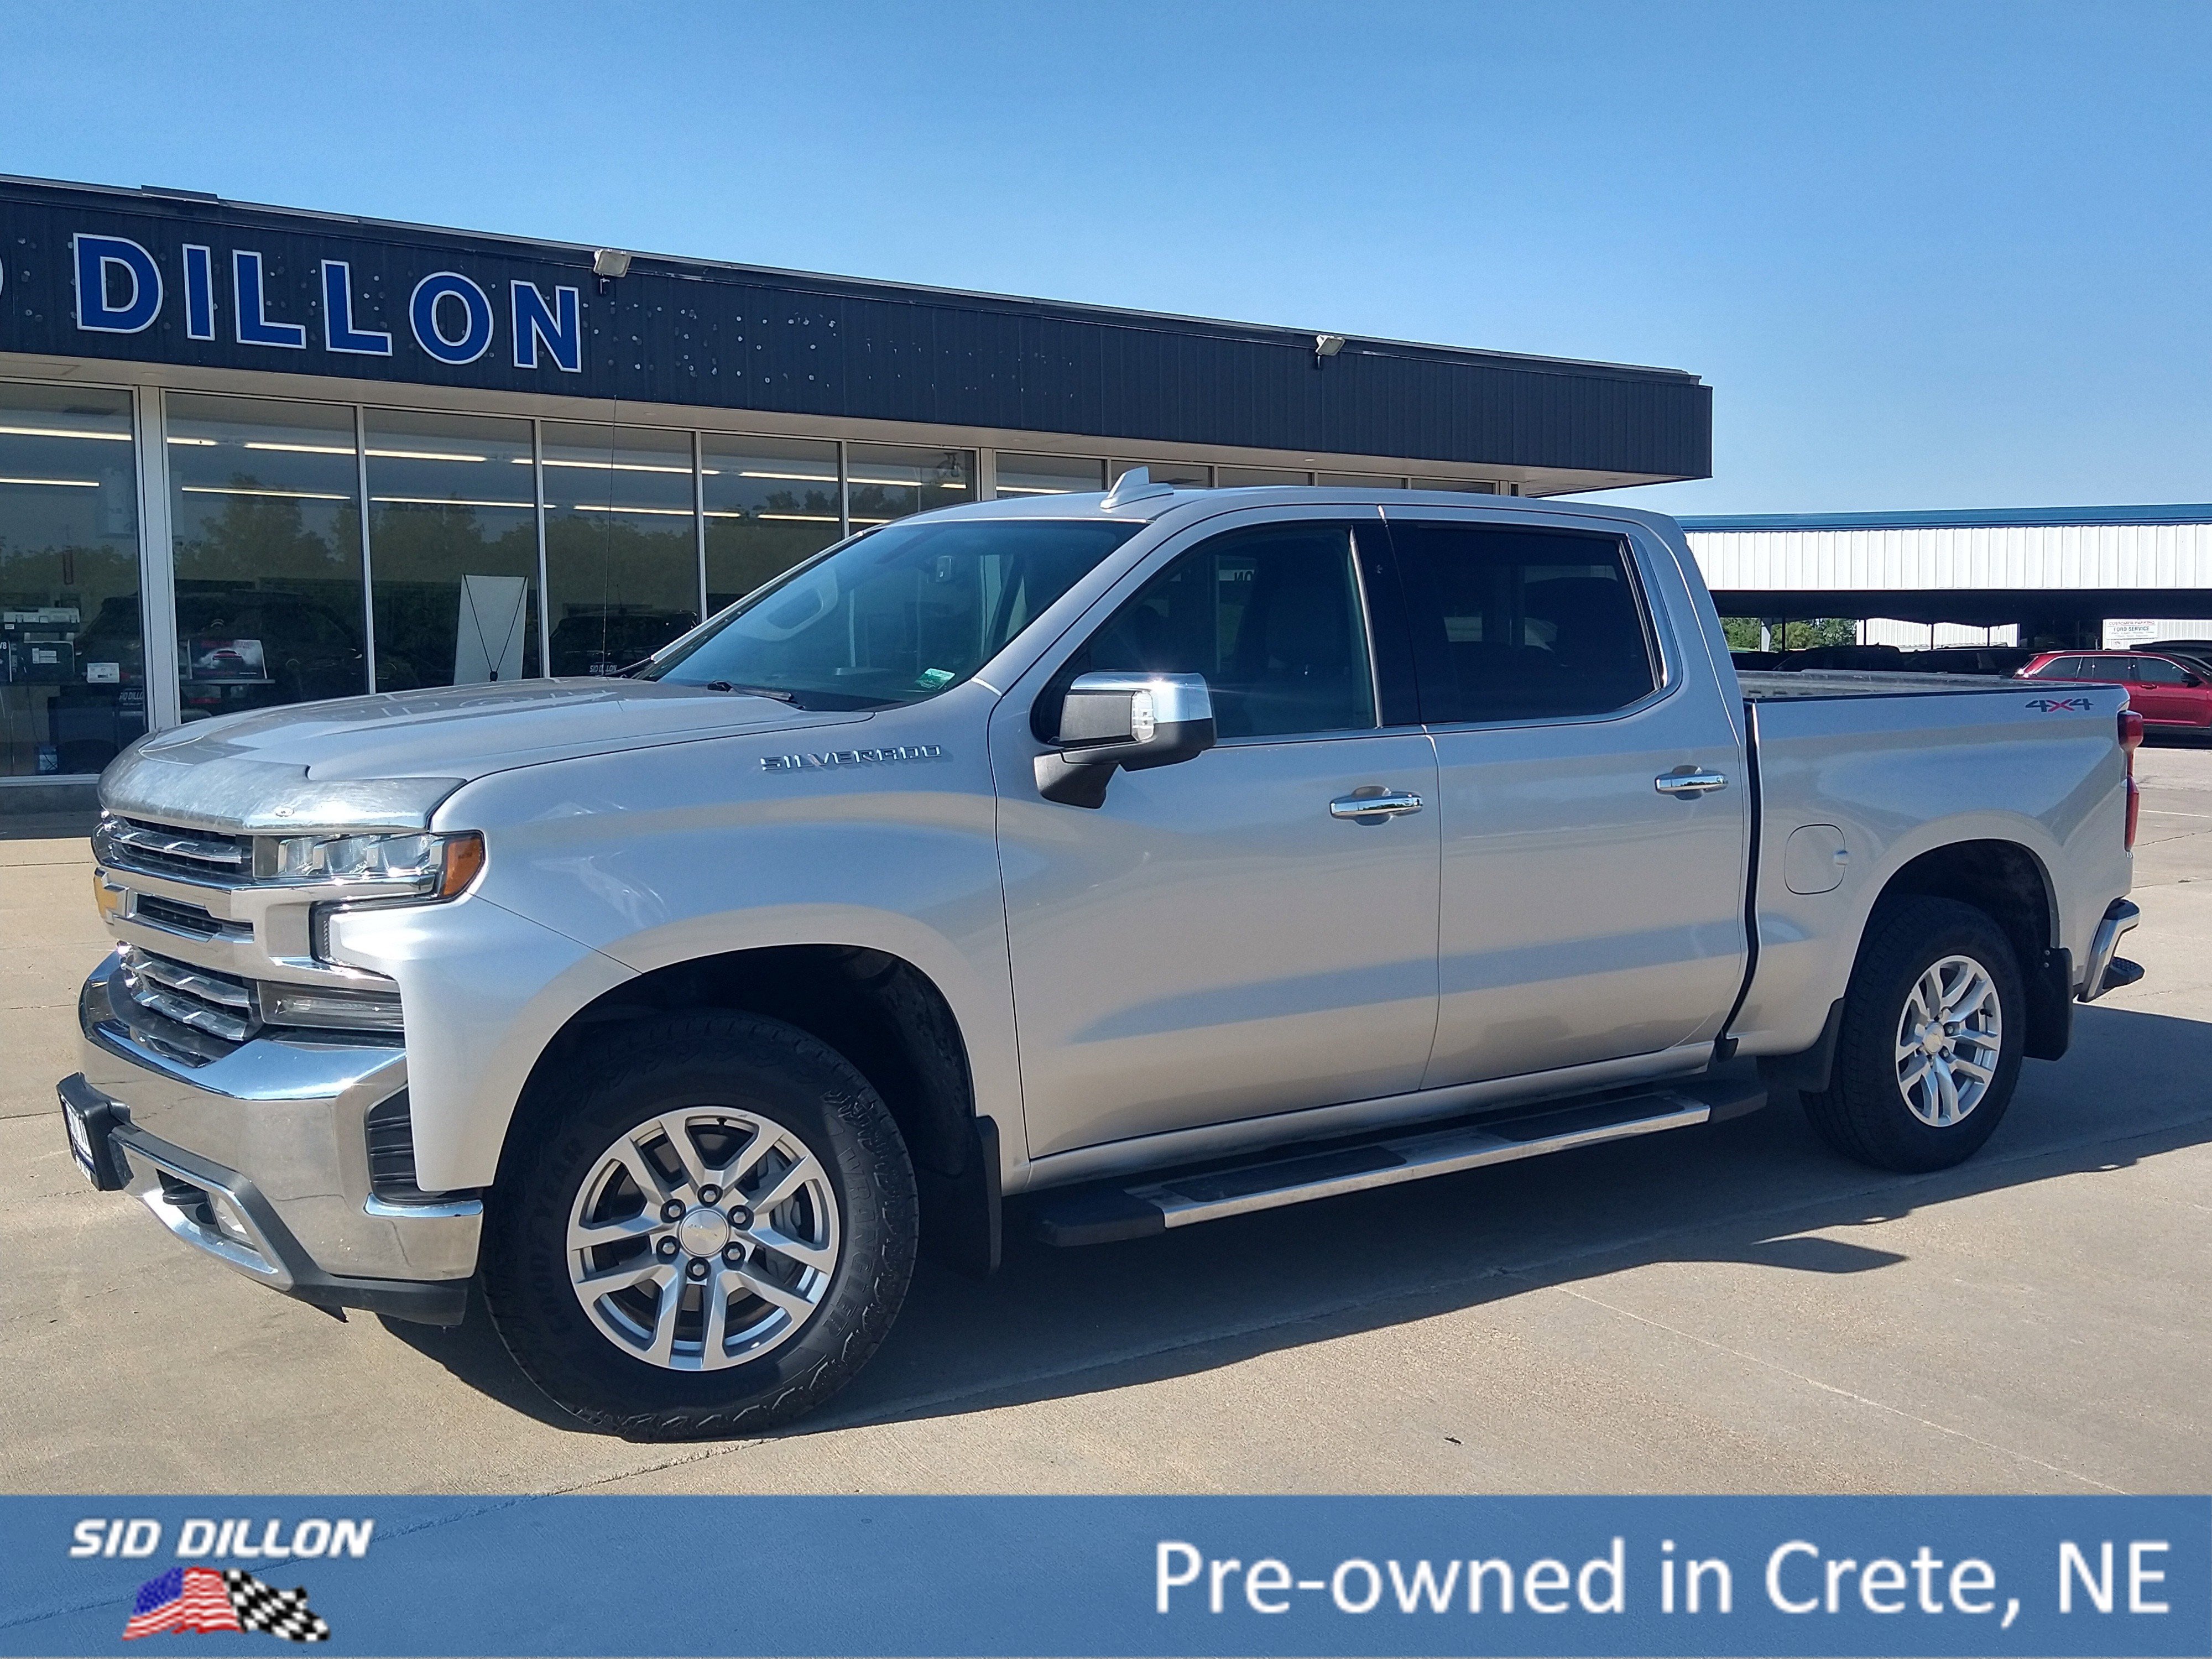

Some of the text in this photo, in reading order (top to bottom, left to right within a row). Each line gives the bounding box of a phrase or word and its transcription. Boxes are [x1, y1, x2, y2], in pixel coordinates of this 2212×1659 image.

[72, 232, 581, 373] DILLON
[760, 744, 941, 770] SILVERADO
[822, 1147, 875, 1338] WRANGLER
